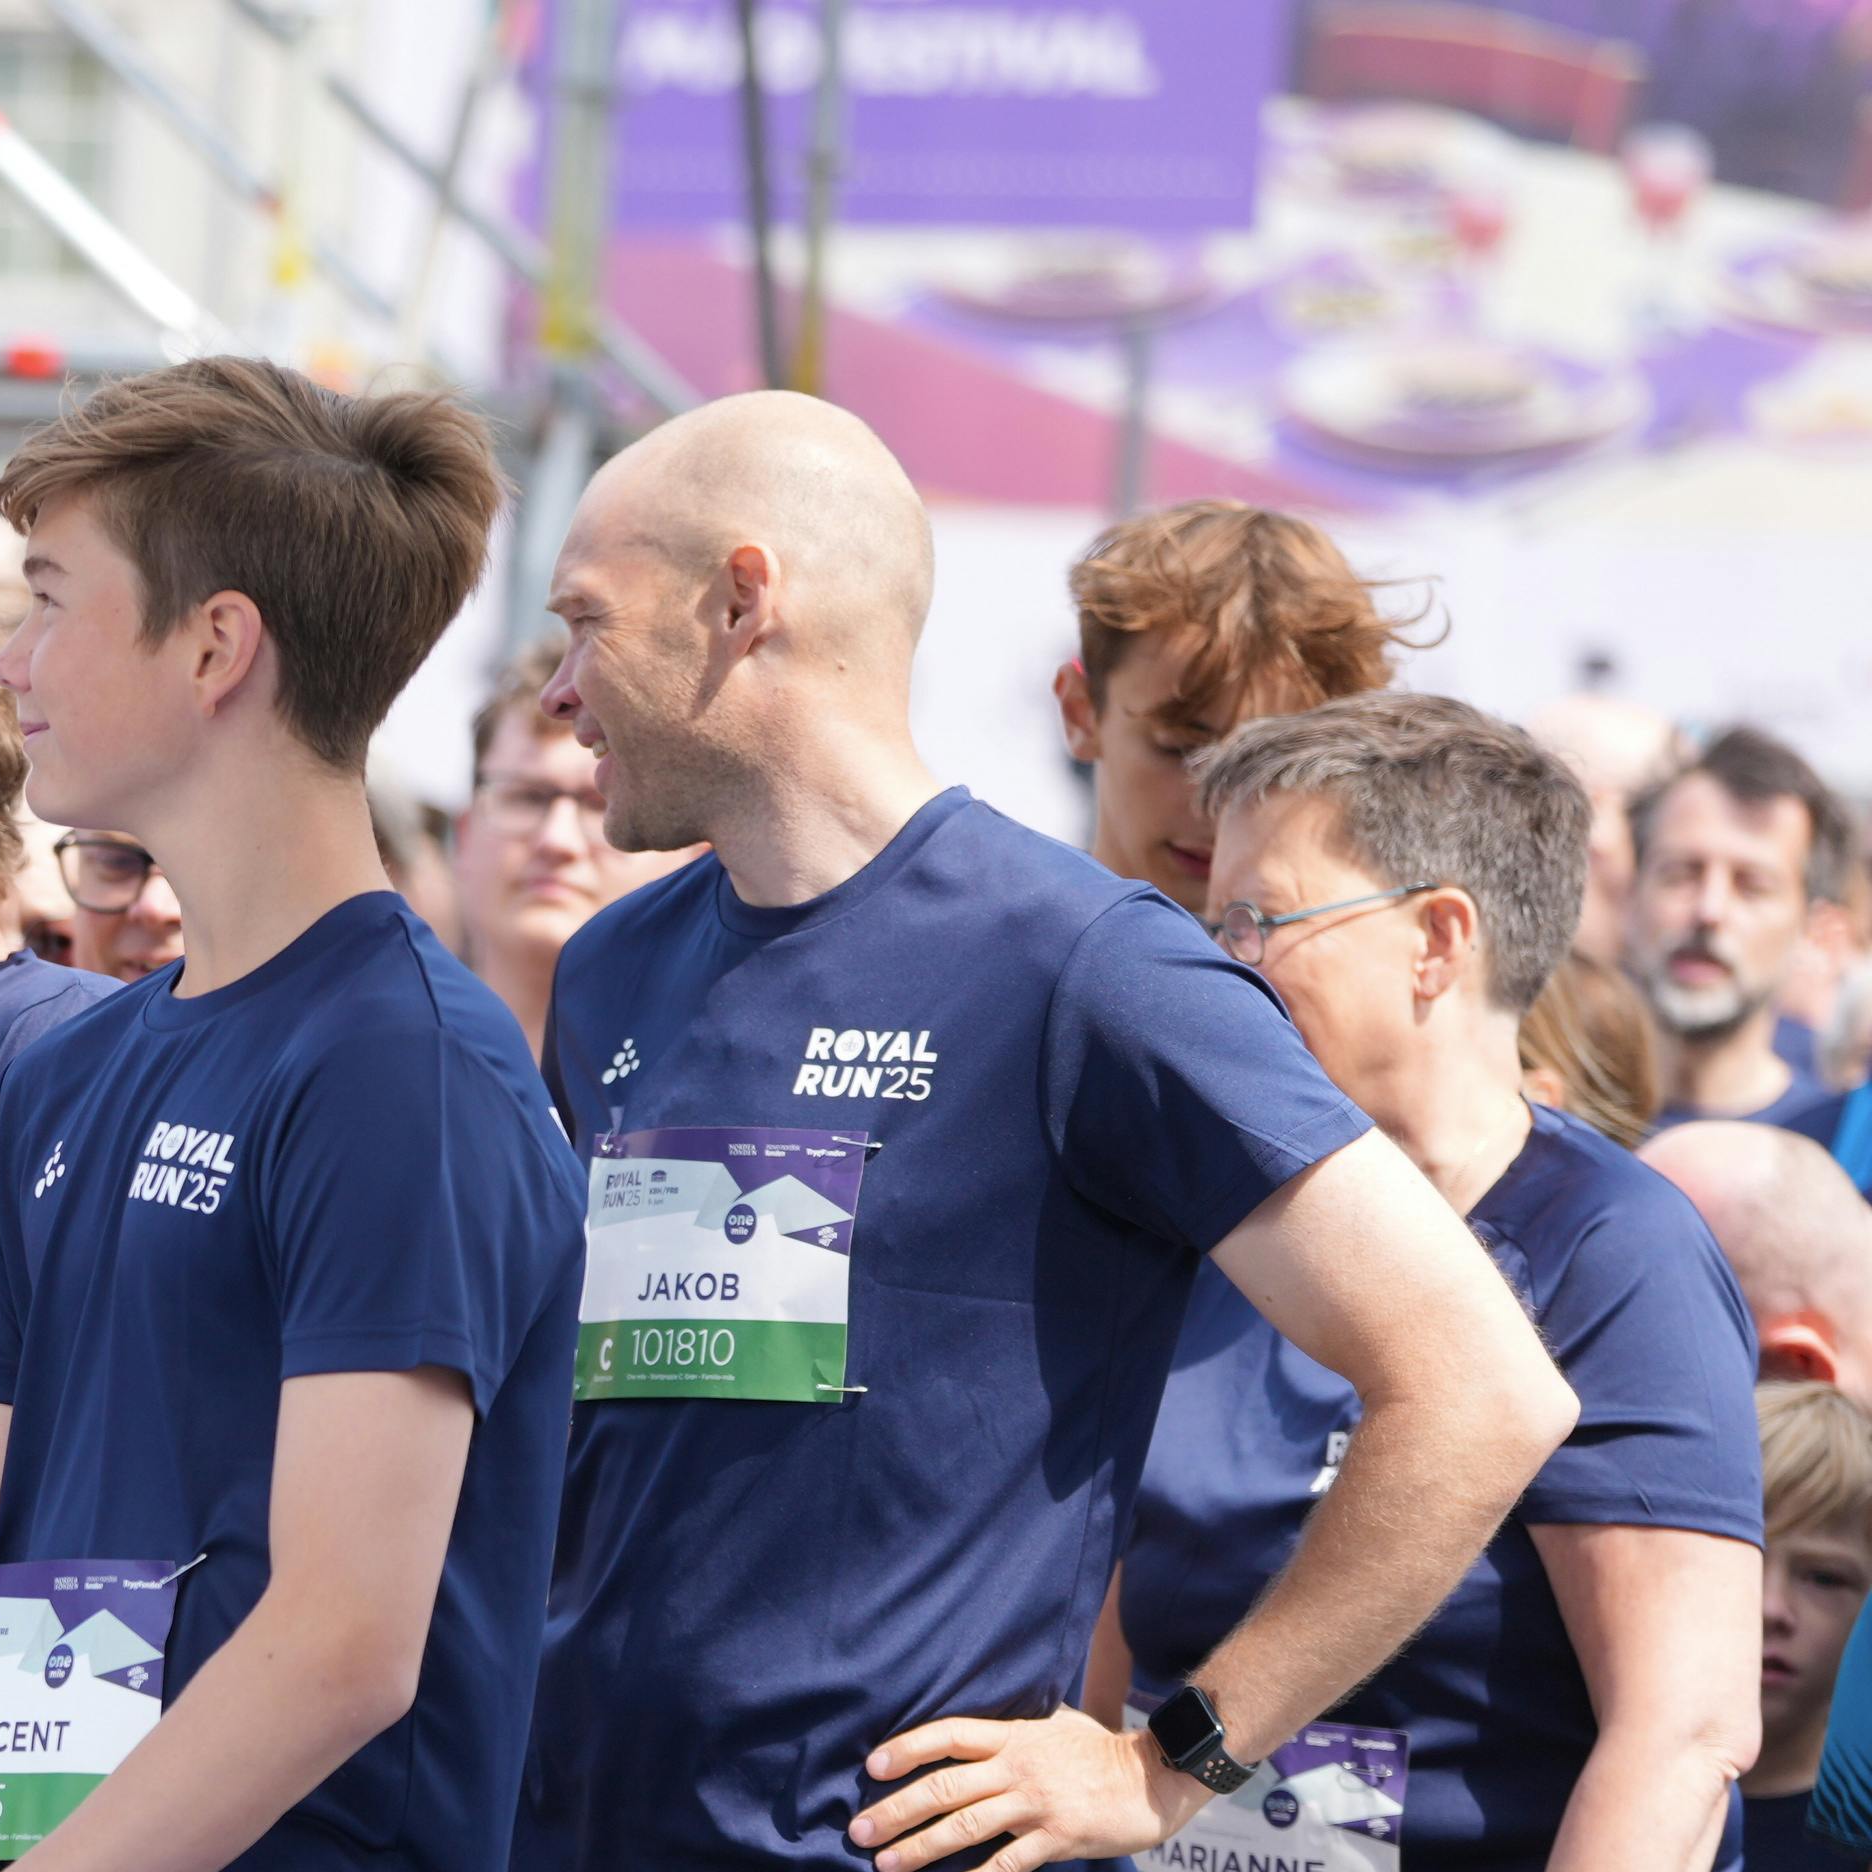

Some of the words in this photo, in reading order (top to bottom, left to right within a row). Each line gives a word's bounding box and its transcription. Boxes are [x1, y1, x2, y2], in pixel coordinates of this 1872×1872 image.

[806, 1027, 938, 1063] ROYAL
[144, 1121, 235, 1174] ROYAL
[606, 1170, 642, 1189] ROYAL
[727, 1213, 755, 1227] one
[730, 1226, 749, 1236] mile
[638, 1272, 740, 1302] JAKOB
[599, 1338, 613, 1371] C
[631, 1328, 735, 1367] 101810
[48, 1654, 72, 1668] one
[48, 1669, 66, 1679] mile
